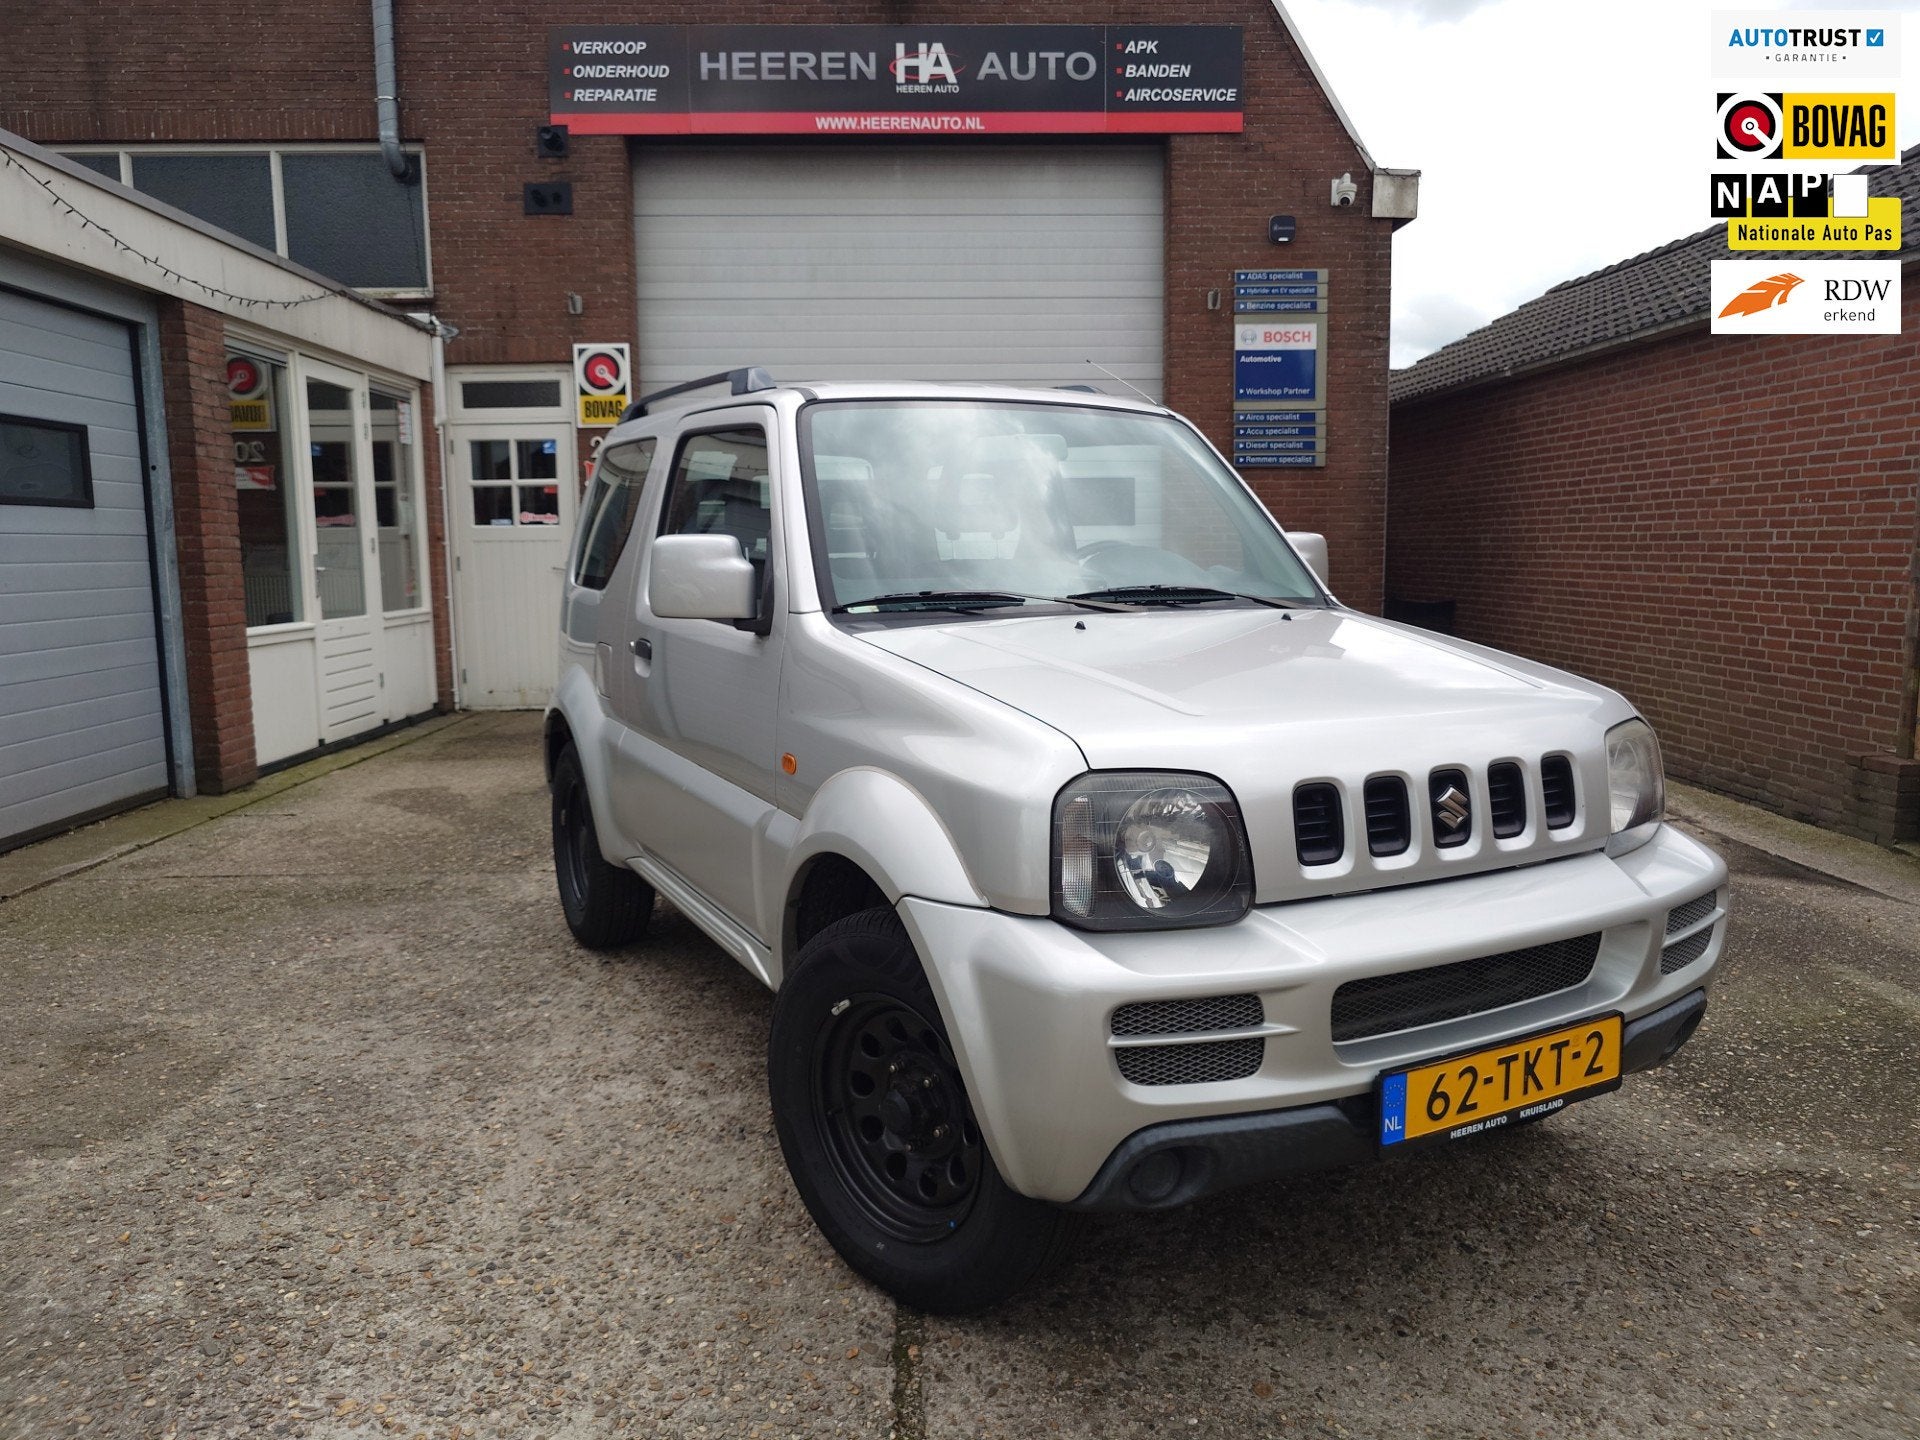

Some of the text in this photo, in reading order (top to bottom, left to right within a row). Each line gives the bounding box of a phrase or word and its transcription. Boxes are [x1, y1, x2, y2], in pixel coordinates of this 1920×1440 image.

[572, 42, 647, 55] VERKOOP
[1125, 40, 1159, 54] APK
[573, 65, 670, 79] ONDERHOUD
[700, 52, 1097, 81] HEEREN AUTO
[1125, 64, 1191, 78] BANDEN
[573, 89, 658, 102] REPARATIE
[896, 85, 960, 94] HEEREN AUTO
[1125, 88, 1237, 102] AIRCOSERVICE
[815, 116, 985, 130] WWW.HEERENAUTO.NL
[1269, 272, 1303, 281] specialist
[1247, 302, 1311, 310] Benzine specialist
[1263, 331, 1312, 343] BOSCH
[1240, 355, 1282, 363] Automotive
[1245, 387, 1282, 396] Workshop
[584, 400, 622, 418] BOVAG
[1266, 414, 1300, 422] specialist
[1265, 428, 1299, 436] specialist
[1269, 442, 1303, 450] specialist
[1279, 456, 1312, 464] specialist
[1426, 1030, 1604, 1121] 62-TKT-2
[1384, 1116, 1402, 1133] NL
[1450, 1099, 1564, 1139] HEEREN AUTO KRUISLAND
